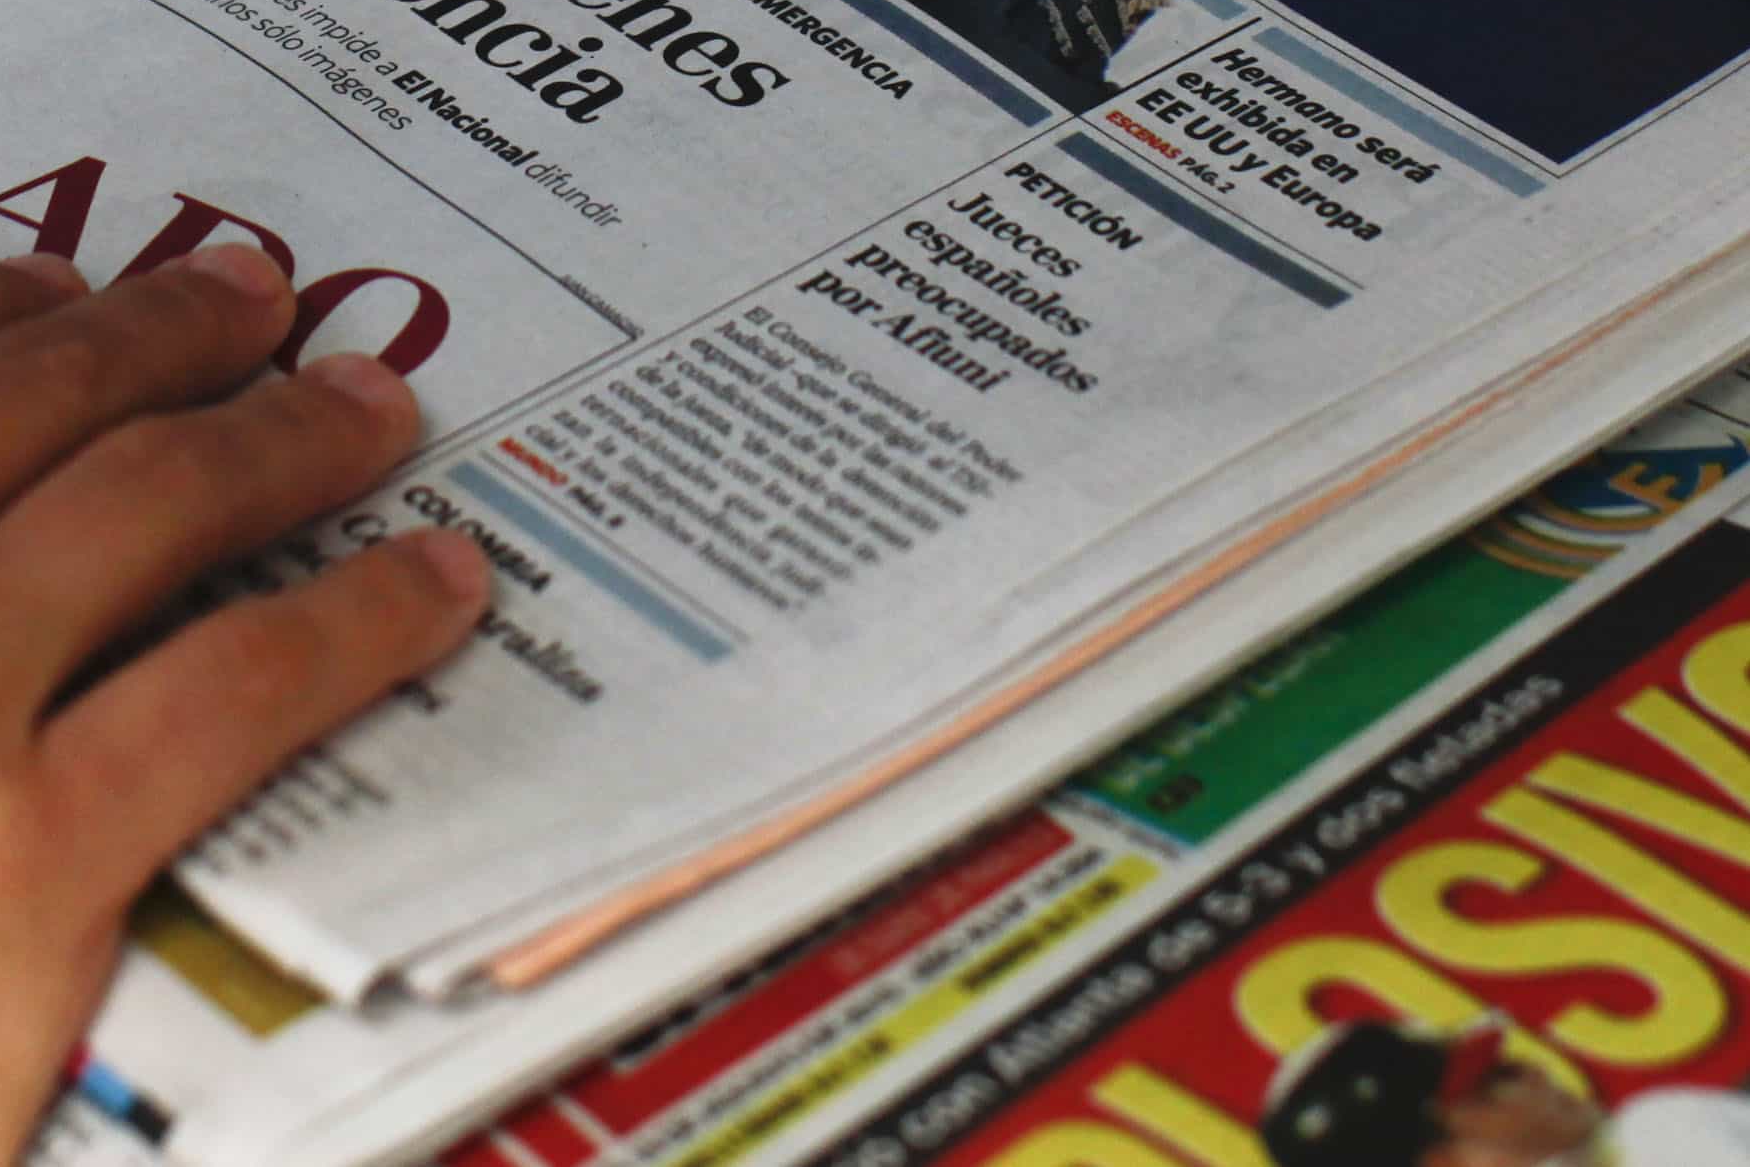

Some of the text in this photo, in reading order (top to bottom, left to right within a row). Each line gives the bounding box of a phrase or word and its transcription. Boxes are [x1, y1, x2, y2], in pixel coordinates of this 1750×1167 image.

[253, 12, 308, 54] sólo
[297, 40, 416, 132] imágenes
[297, 4, 384, 66] impide
[374, 56, 400, 76] a
[392, 69, 427, 103] El
[417, 87, 539, 168] Nacional
[525, 148, 622, 229] difundir
[1176, 73, 1363, 186] exhibida en
[1210, 48, 1443, 186] Hermano será
[1004, 161, 1145, 252] PETICIÓN
[1105, 109, 1237, 195] ESCENAS PÁG. 2
[1136, 88, 1384, 242] EE UU y Europa
[904, 219, 1092, 339] españoles
[948, 192, 1083, 281] Jueces
[796, 267, 1011, 395] por Afiuni
[844, 242, 1099, 395] preocupados
